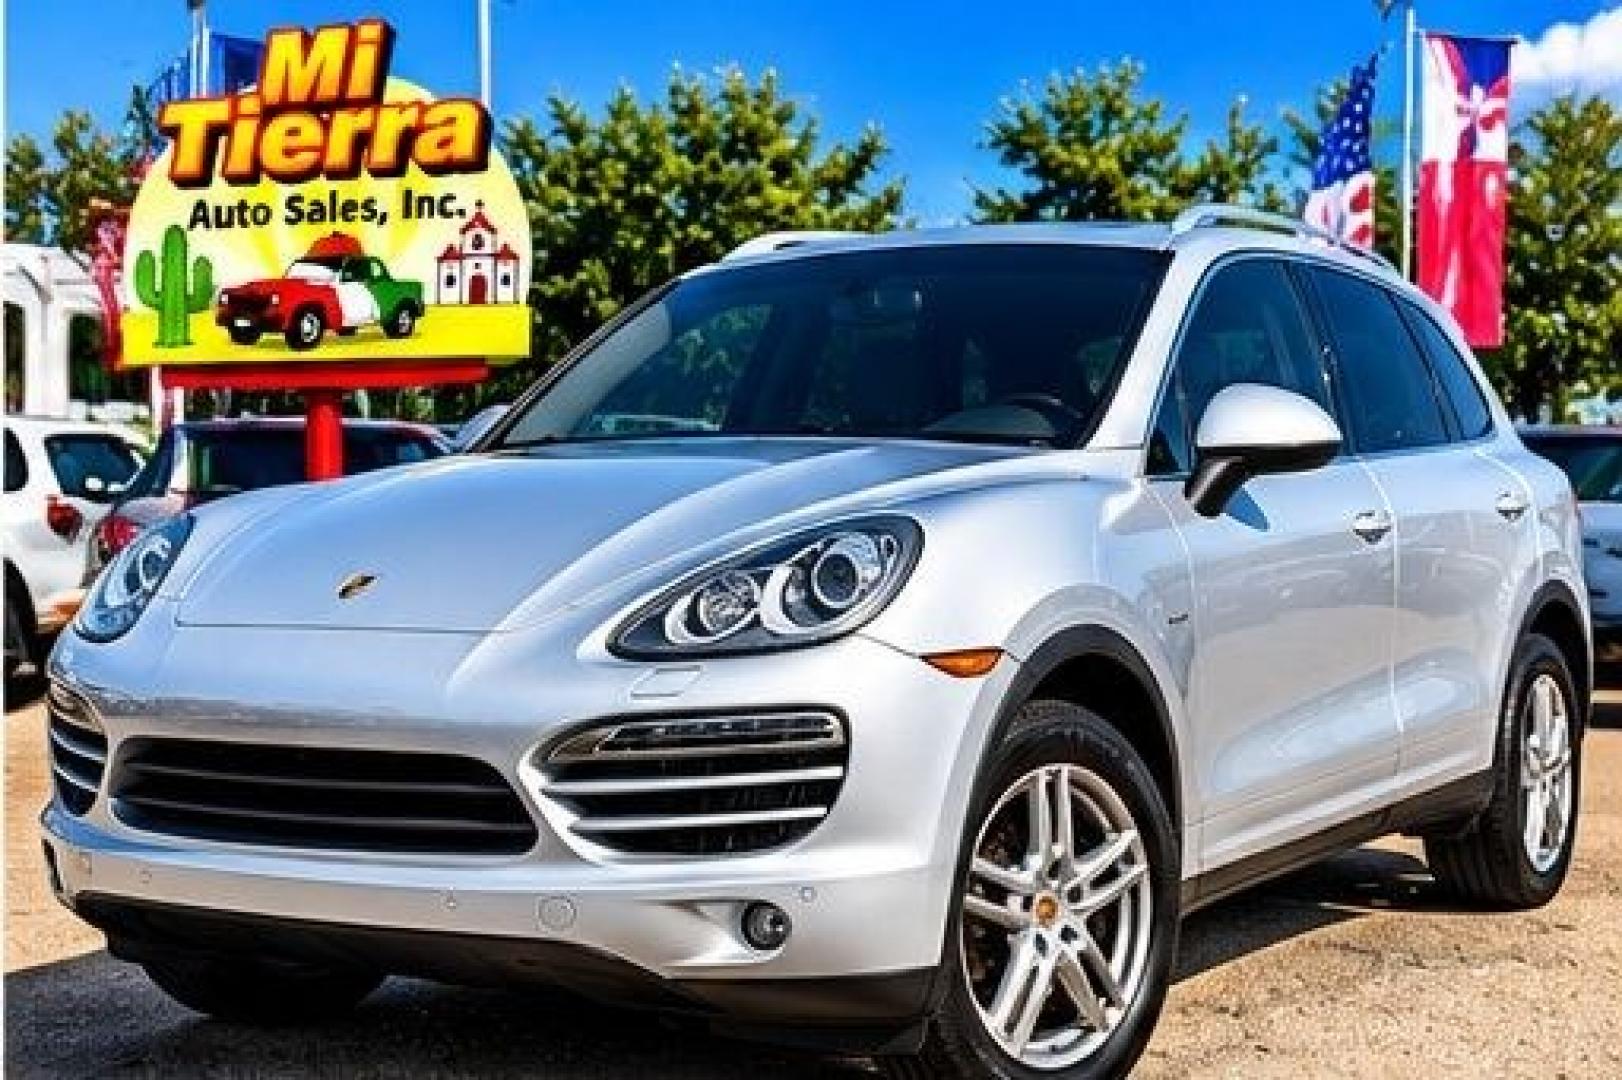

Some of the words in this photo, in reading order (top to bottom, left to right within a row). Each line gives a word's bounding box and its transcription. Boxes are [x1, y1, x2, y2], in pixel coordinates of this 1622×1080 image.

[259, 18, 396, 106] Mi
[159, 96, 491, 187] Tierra
[188, 199, 272, 231] Auto
[284, 190, 388, 226] Sales,
[402, 190, 466, 219] Inc.
